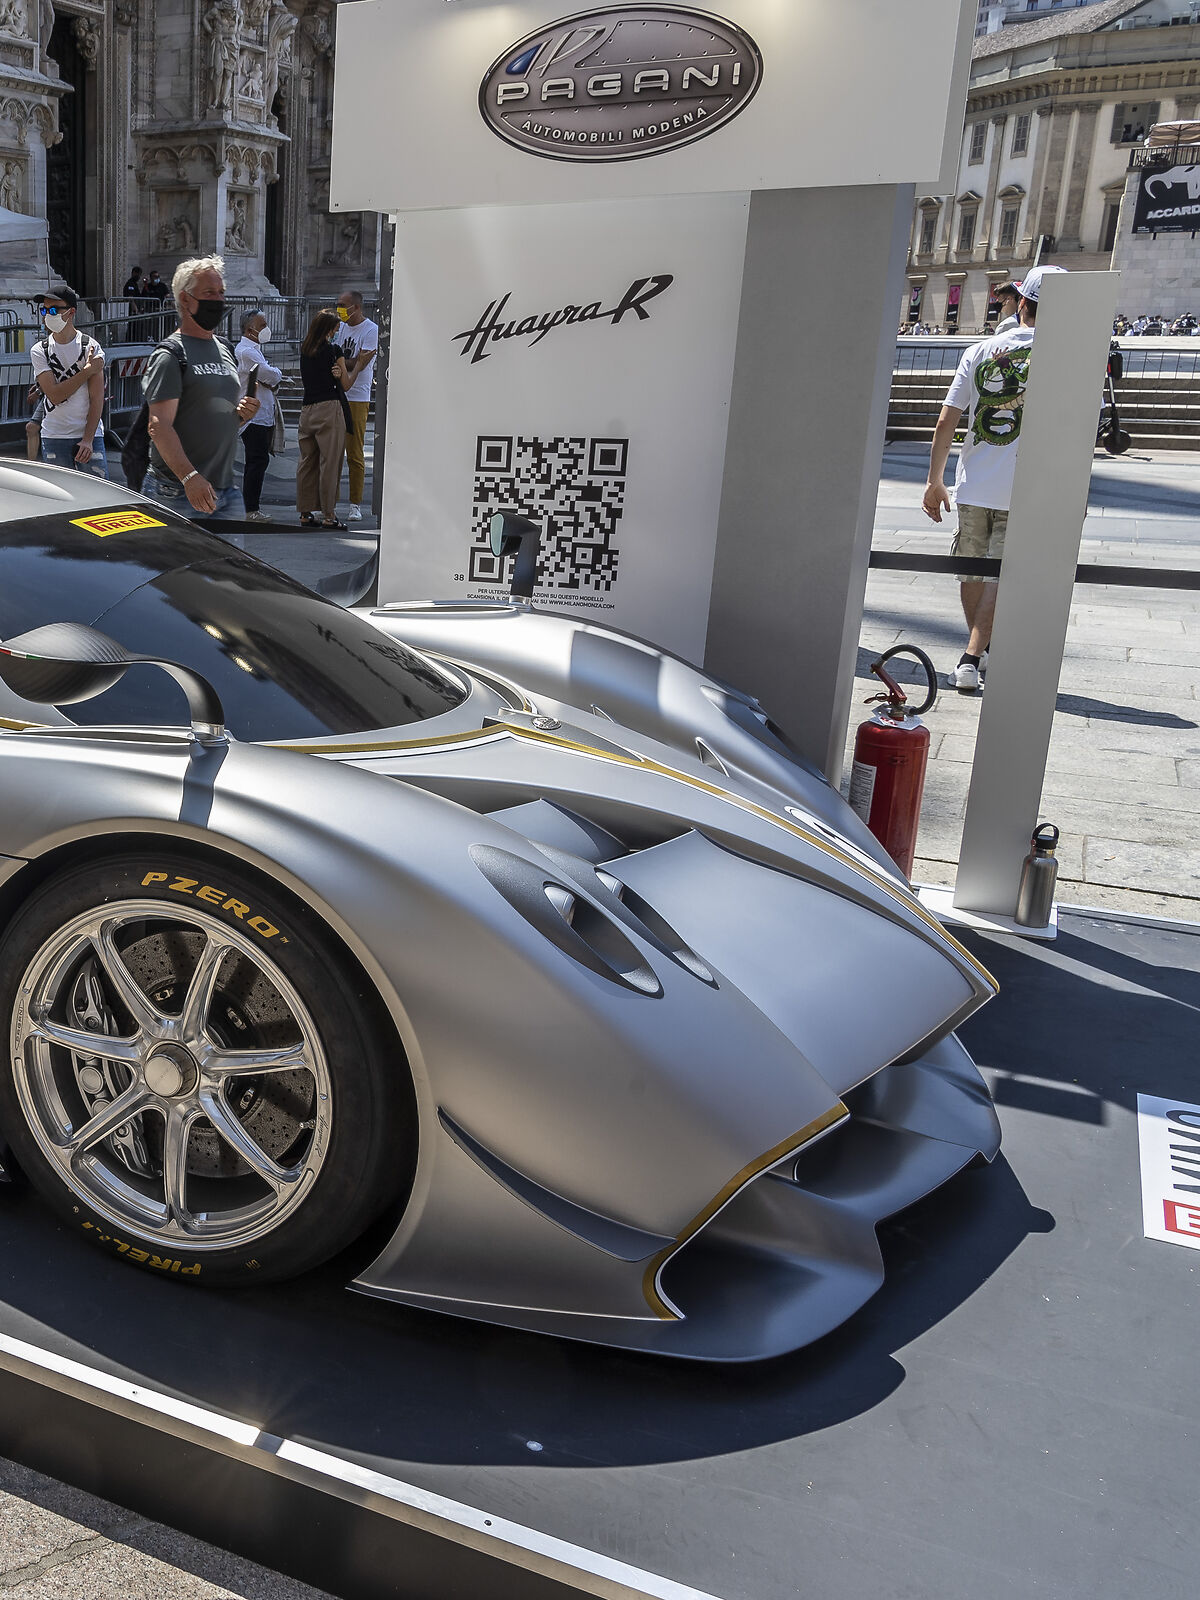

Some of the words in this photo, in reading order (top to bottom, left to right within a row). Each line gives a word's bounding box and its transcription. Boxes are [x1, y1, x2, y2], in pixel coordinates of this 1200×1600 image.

[496, 62, 741, 105] PAGANI
[521, 120, 623, 142] AUTOMOBILI
[632, 107, 708, 138] MODENA
[450, 291, 602, 364] Huayra
[608, 274, 674, 325] R
[83, 514, 156, 532] PIRELLI
